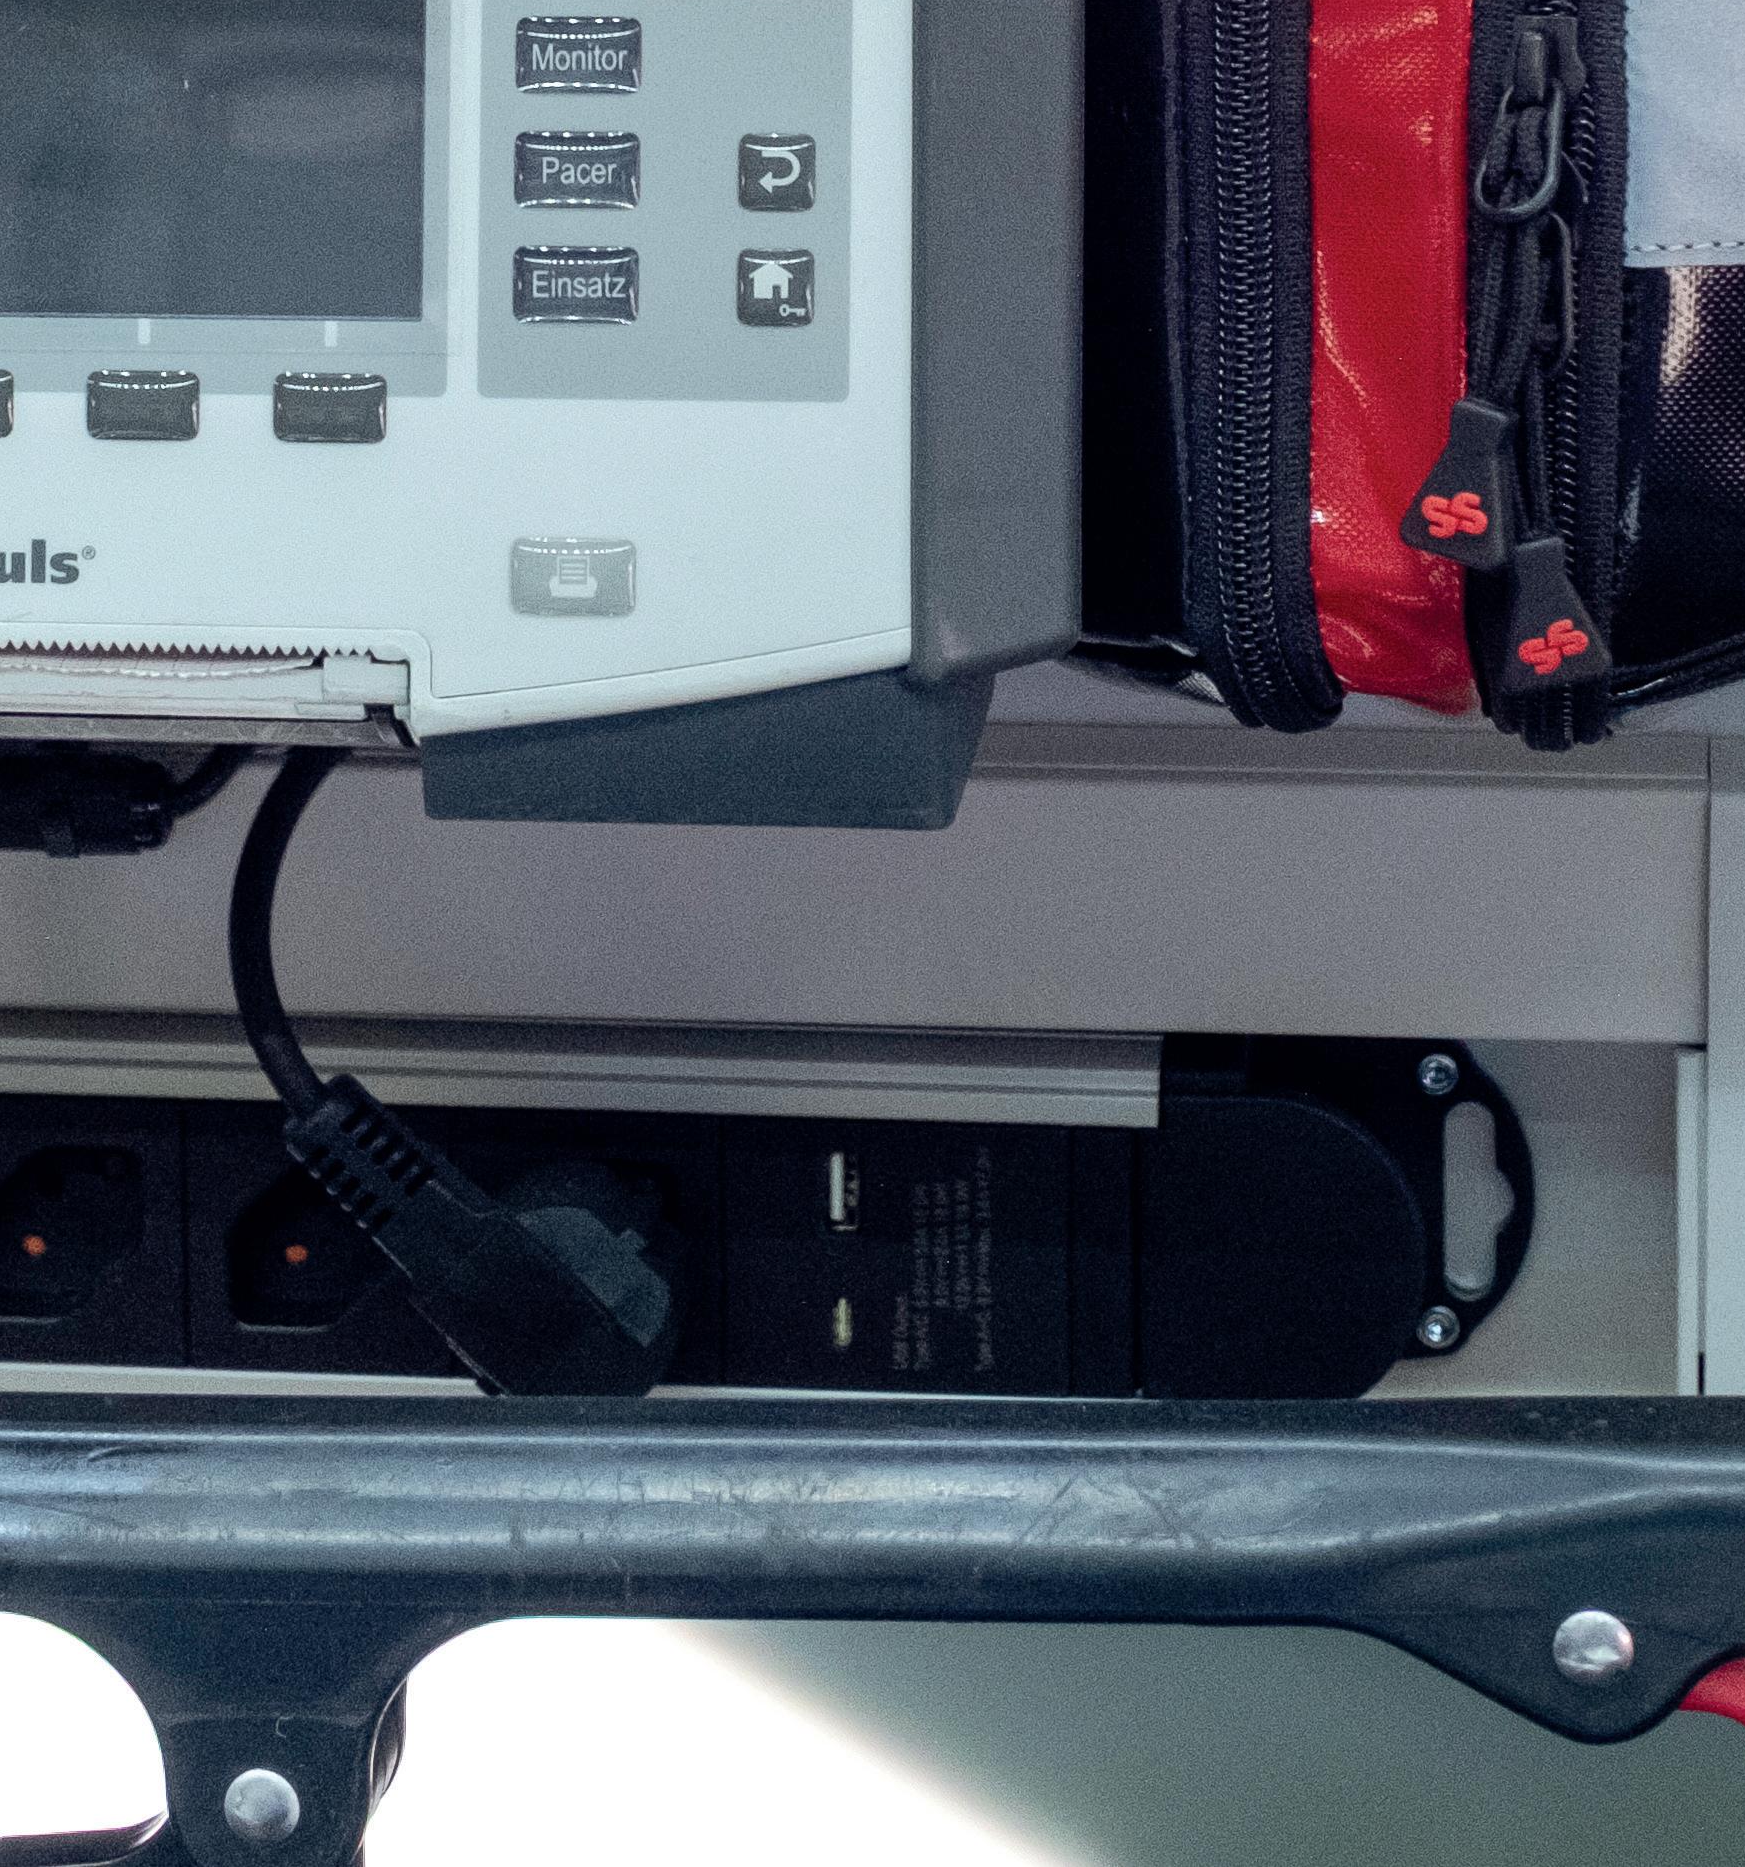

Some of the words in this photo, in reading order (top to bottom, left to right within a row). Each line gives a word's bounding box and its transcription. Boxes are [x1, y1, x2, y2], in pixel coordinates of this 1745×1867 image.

[533, 44, 627, 70] Monitor
[543, 157, 616, 184] Pacer
[533, 271, 625, 297] Einsatz
